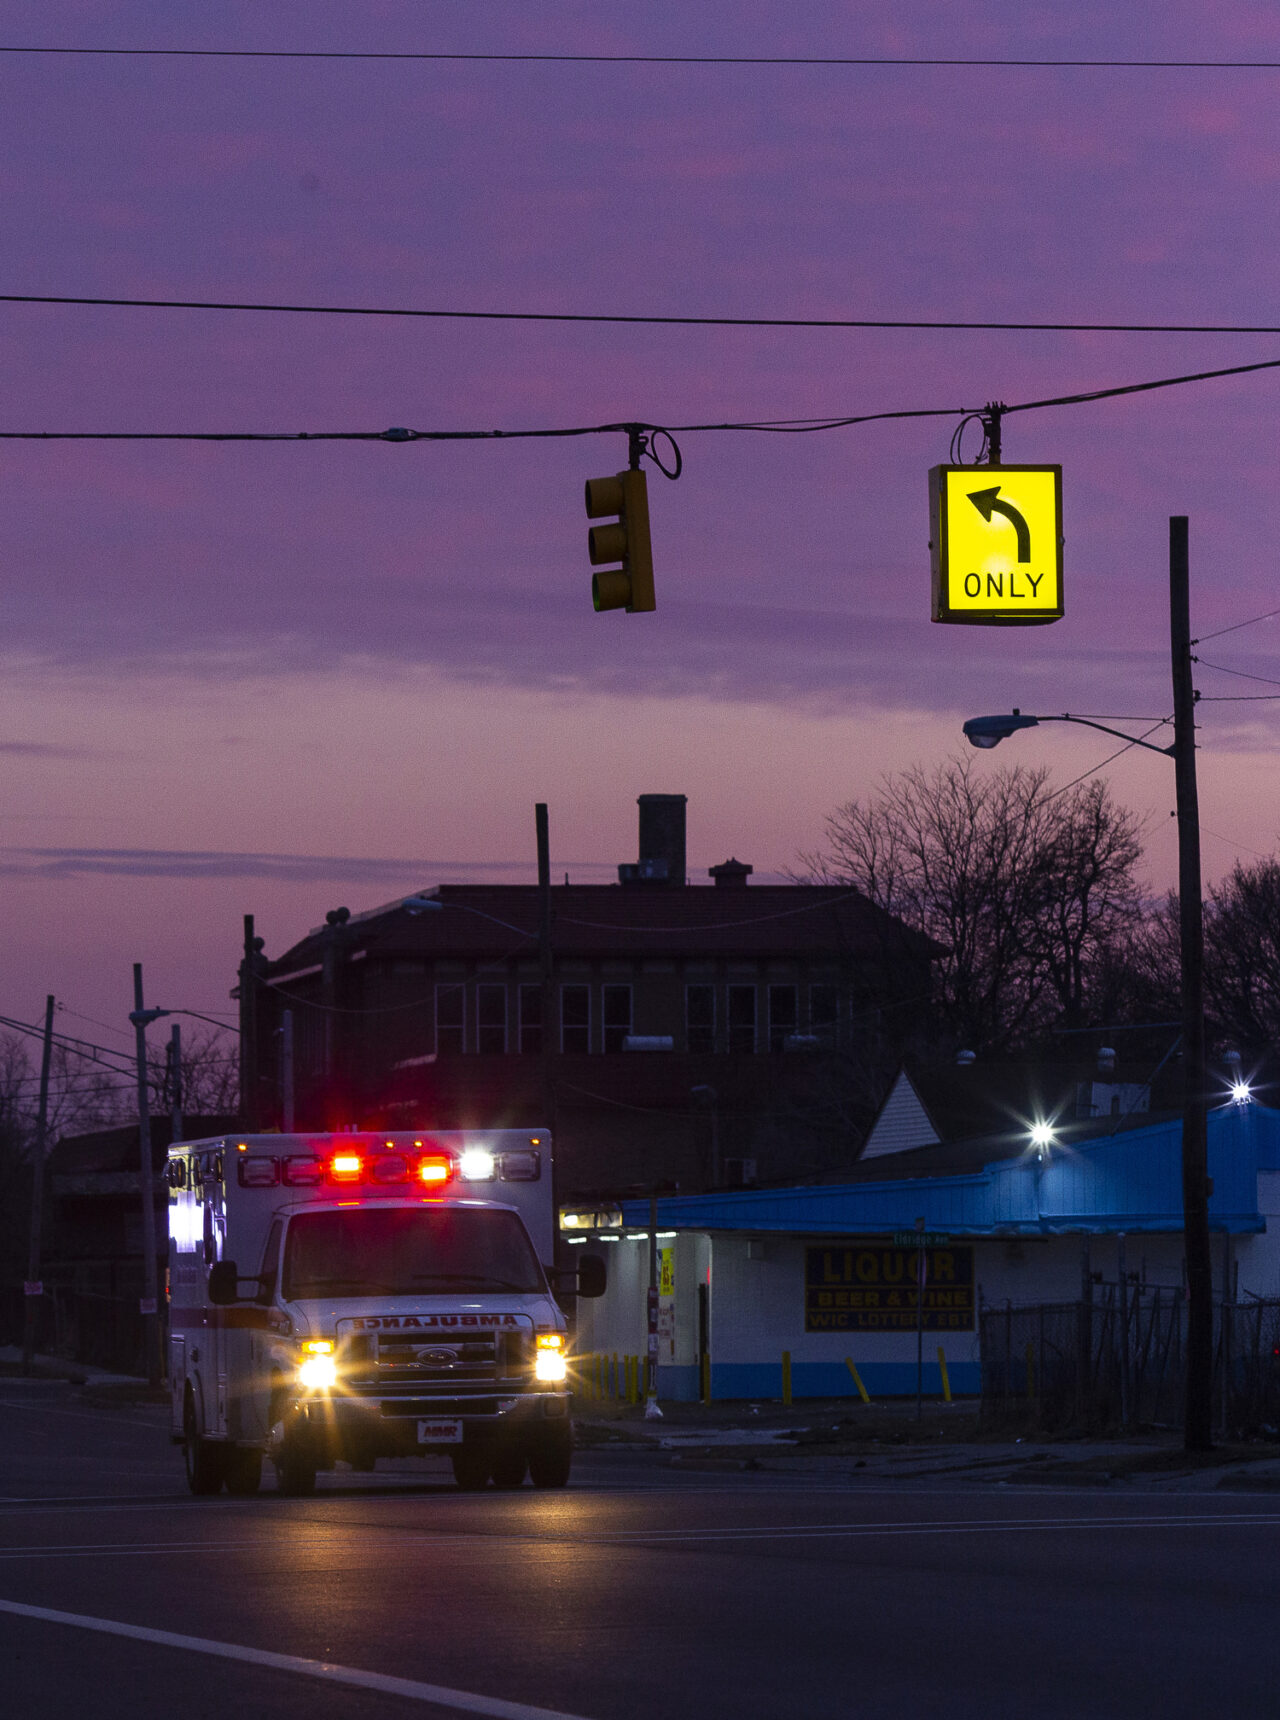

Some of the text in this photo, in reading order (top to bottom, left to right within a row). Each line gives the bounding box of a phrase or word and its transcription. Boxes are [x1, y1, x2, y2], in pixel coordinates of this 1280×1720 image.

[964, 573, 1044, 597] ONLY
[823, 1251, 956, 1283] LIQUOR
[818, 1290, 969, 1306] BEER & WINE
[809, 1313, 970, 1327] WIC LOTTERY EBT
